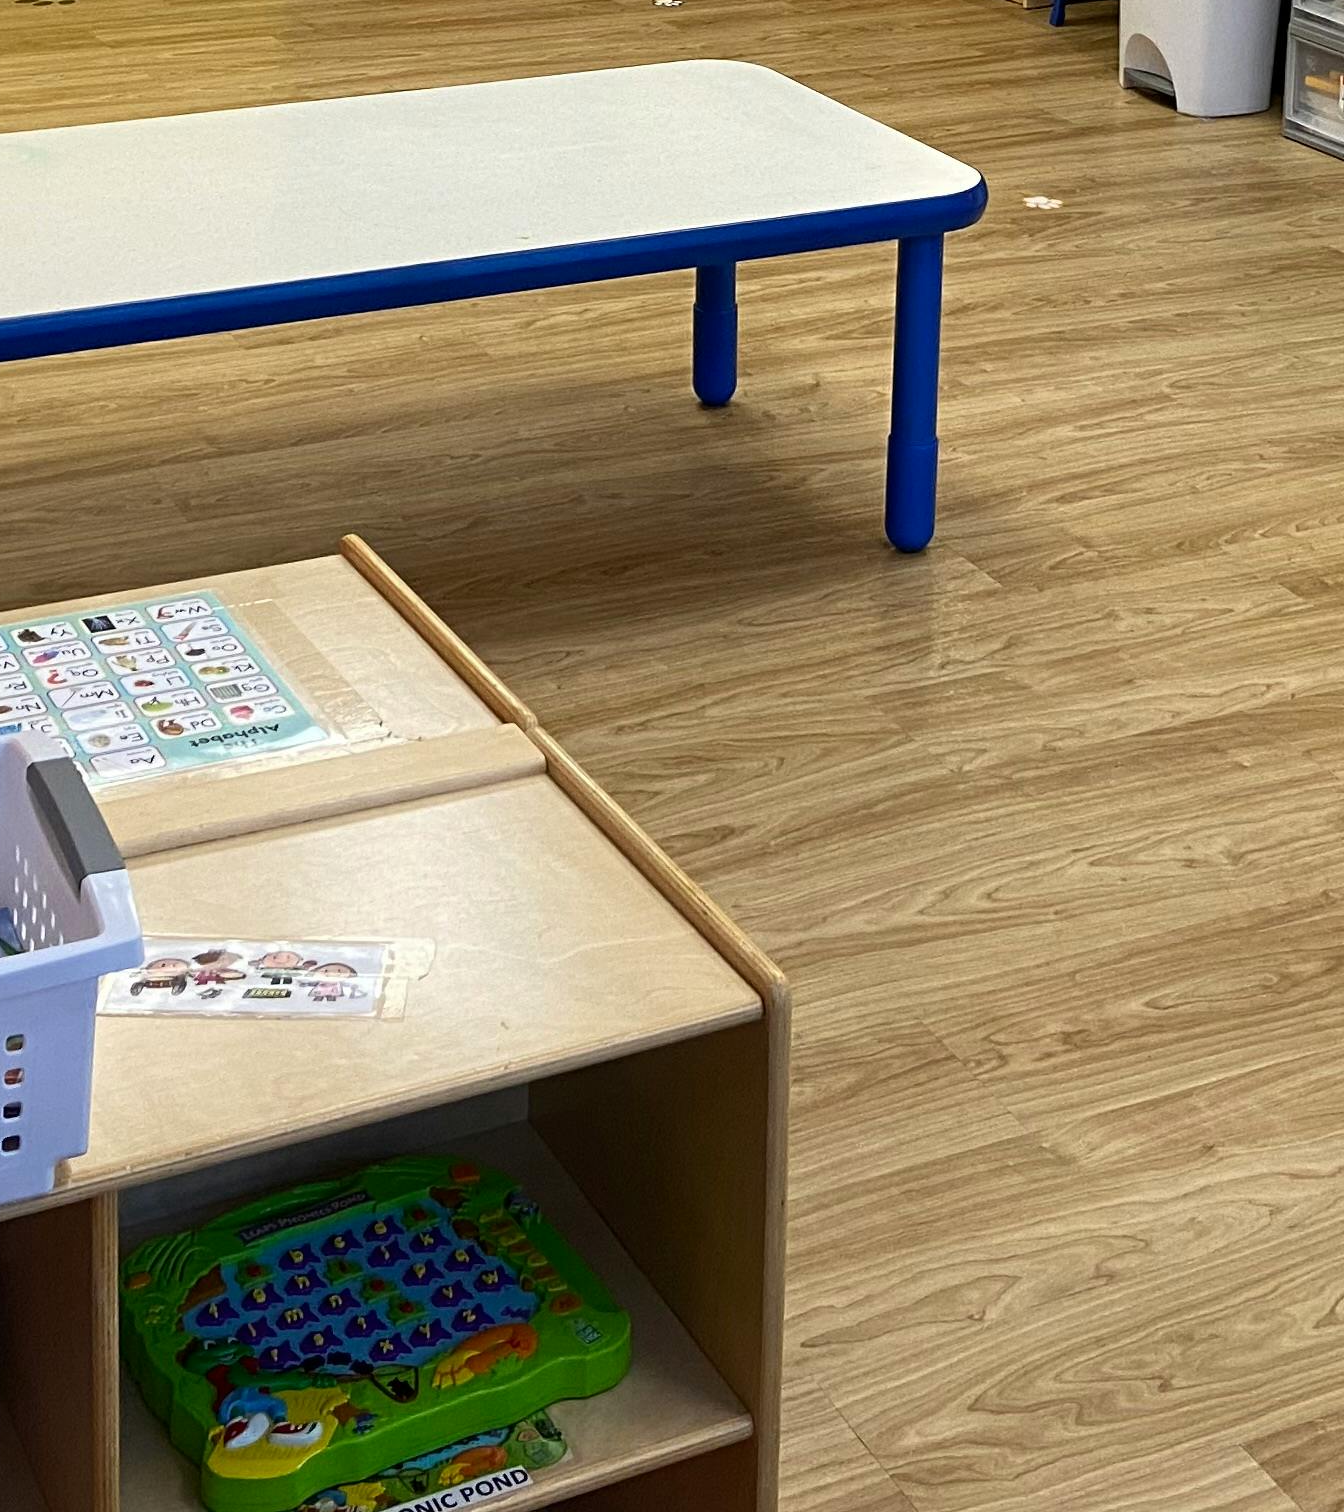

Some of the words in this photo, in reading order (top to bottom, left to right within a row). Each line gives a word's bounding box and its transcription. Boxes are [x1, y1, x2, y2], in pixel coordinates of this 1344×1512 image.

[189, 723, 279, 748] Alphabet
[191, 719, 215, 729] Dd
[399, 1493, 457, 1512] NIC
[459, 1469, 529, 1502] POND
